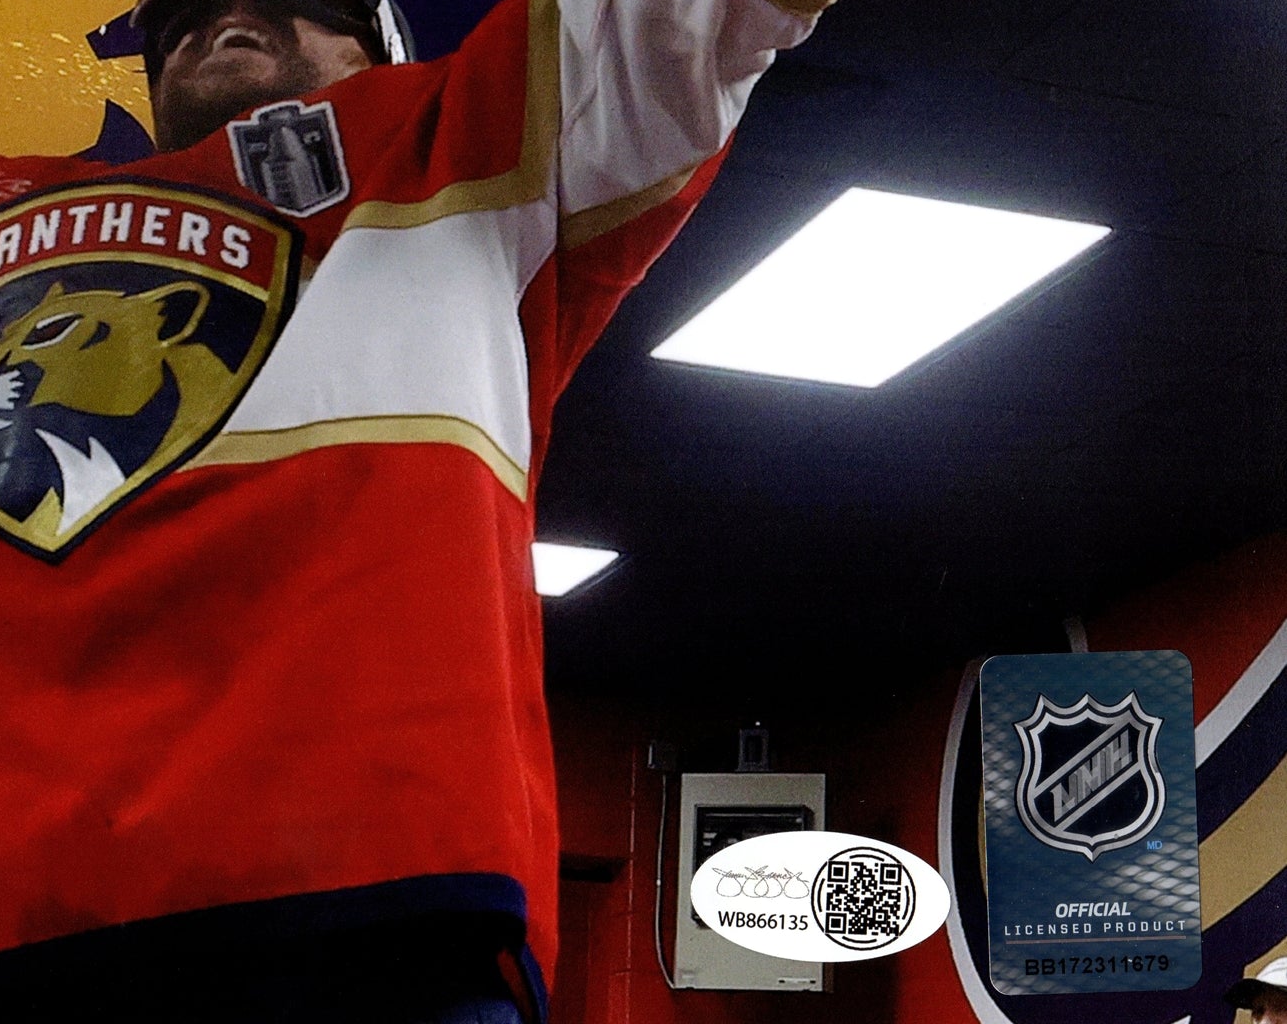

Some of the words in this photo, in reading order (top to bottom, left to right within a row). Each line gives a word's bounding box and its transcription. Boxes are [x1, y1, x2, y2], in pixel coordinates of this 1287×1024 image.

[1146, 840, 1163, 850] MD
[1055, 902, 1132, 919] OFFICIAL
[718, 910, 808, 931] WB866135
[1004, 923, 1092, 936] LICENSED
[1103, 920, 1186, 933] PRODUCT
[1025, 955, 1170, 976] BB172311679
